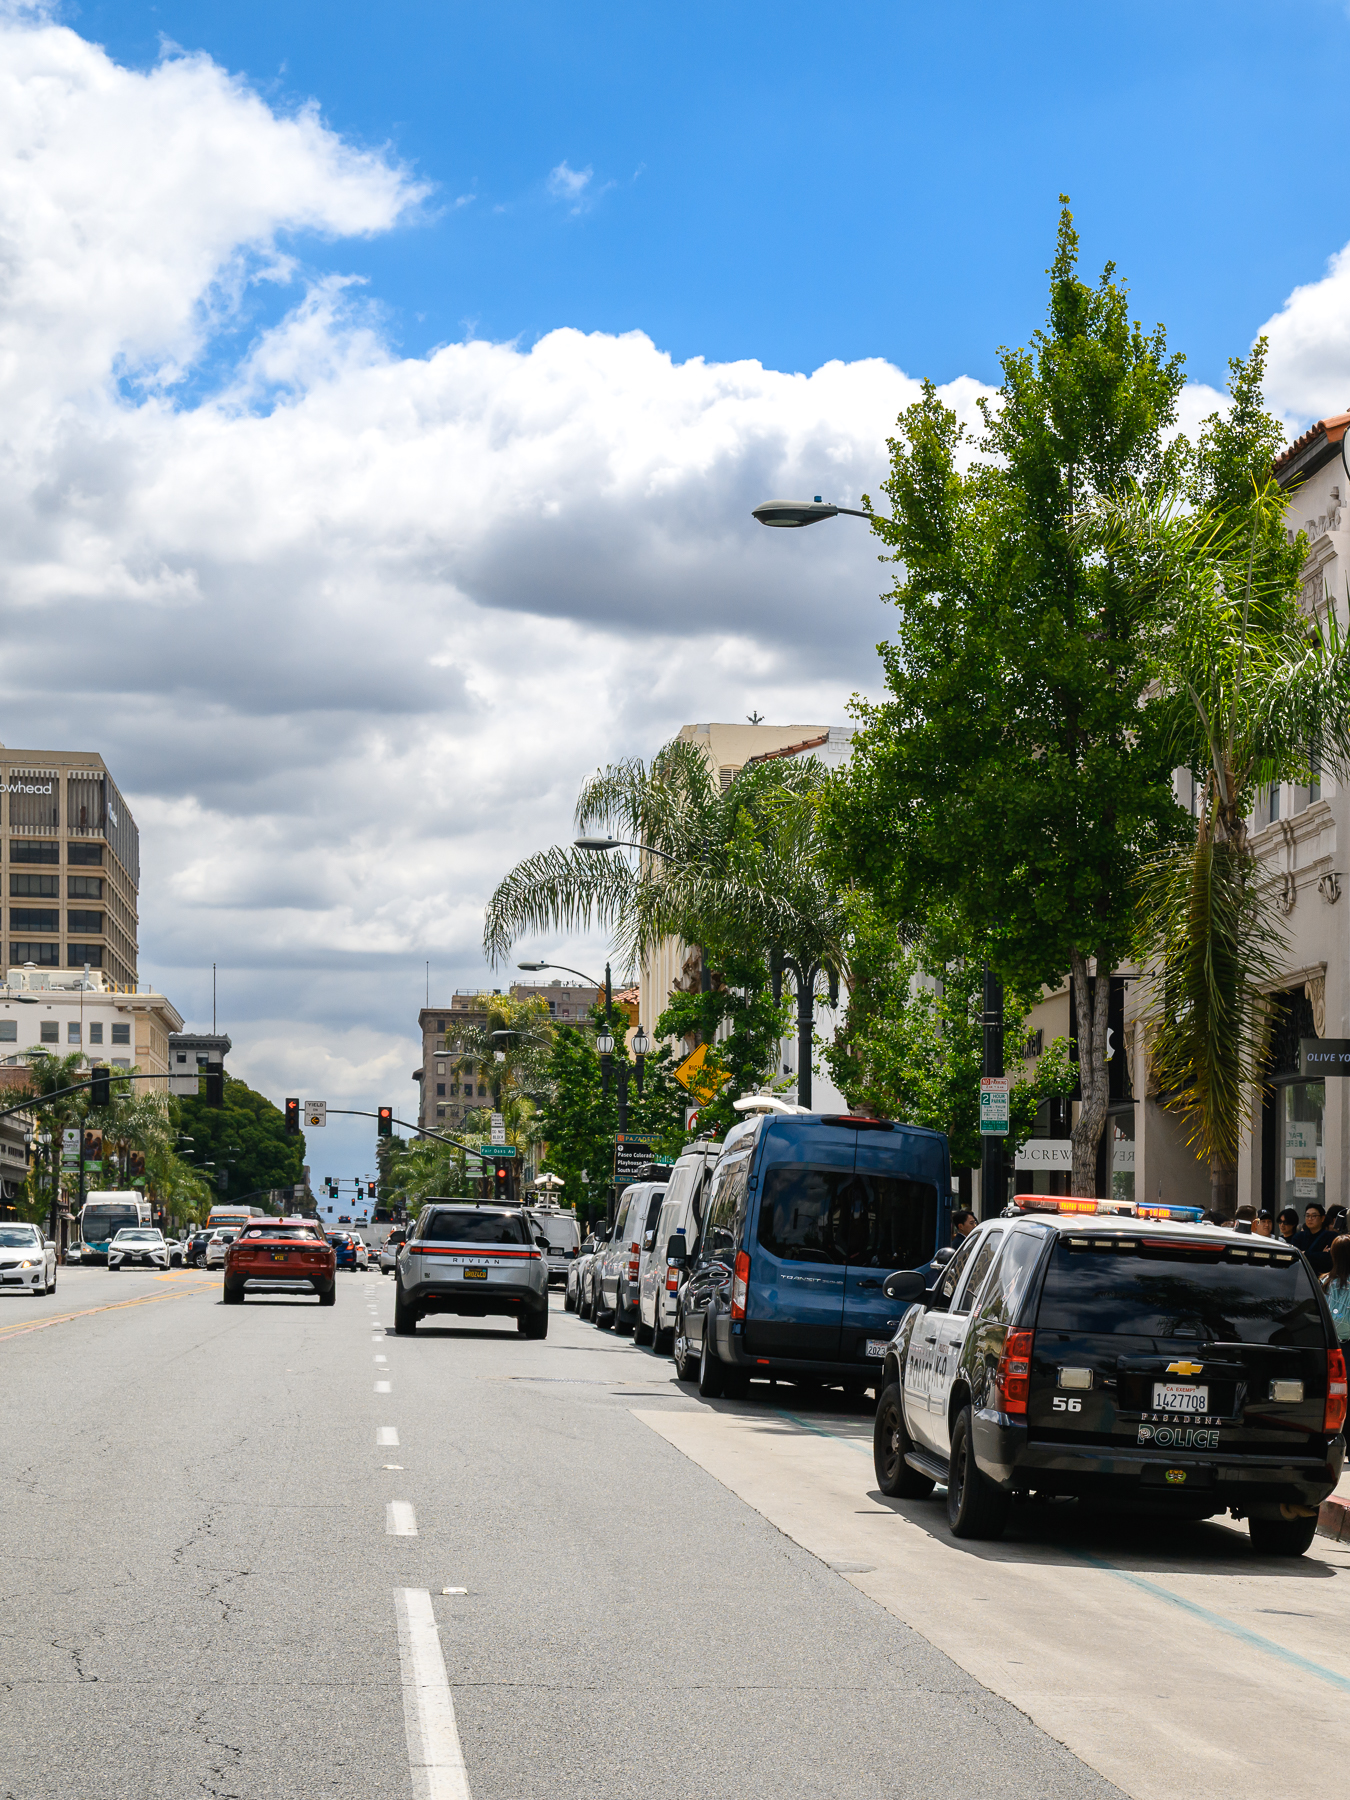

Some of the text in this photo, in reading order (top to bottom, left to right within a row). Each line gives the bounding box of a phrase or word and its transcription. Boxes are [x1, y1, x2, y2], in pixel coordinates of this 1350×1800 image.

[1307, 1052, 1336, 1062] OLIVE
[982, 1094, 989, 1104] 2
[453, 1257, 500, 1265] RIVIAN
[781, 1274, 821, 1282] TRANSIT
[908, 1355, 933, 1392] POLICE
[1052, 1397, 1082, 1412] 56
[1155, 1393, 1206, 1409] 1427708
[1141, 1413, 1222, 1425] PASADENA
[1137, 1424, 1220, 1448] POLICE
